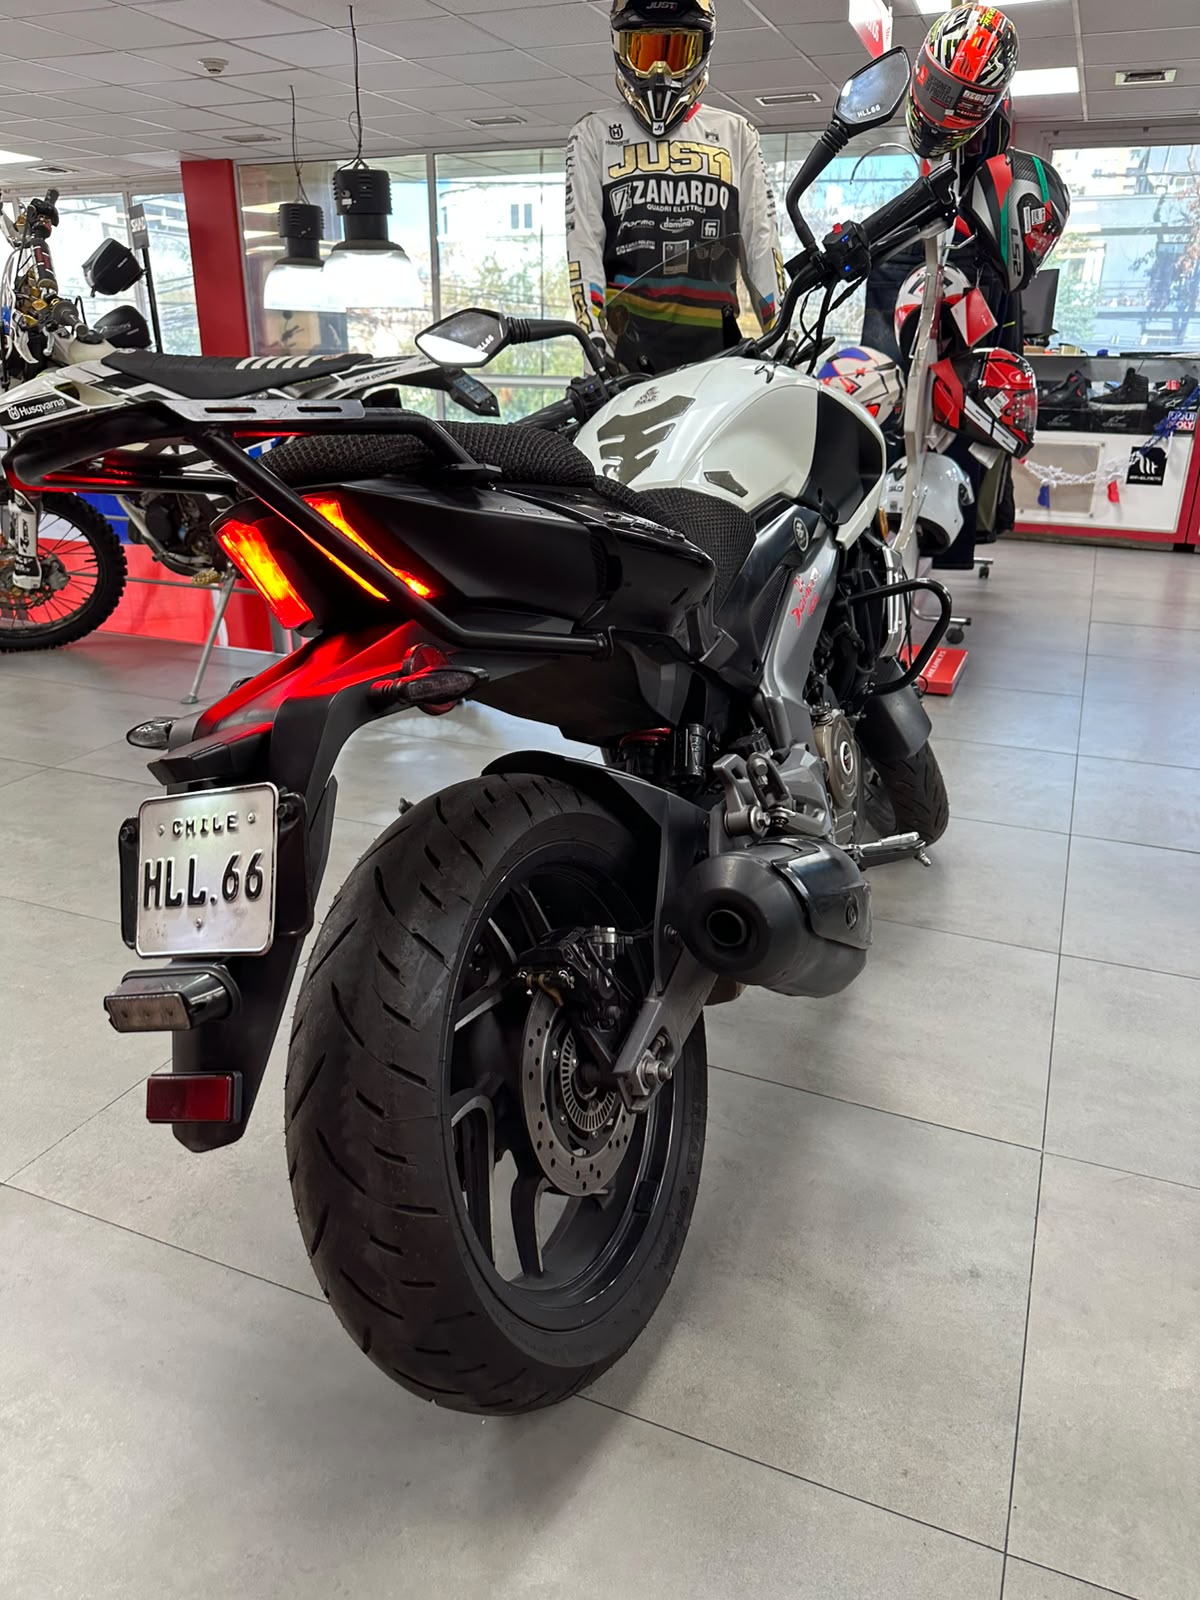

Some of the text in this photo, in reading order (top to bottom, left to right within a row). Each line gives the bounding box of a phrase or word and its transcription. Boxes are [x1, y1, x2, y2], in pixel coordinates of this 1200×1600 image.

[857, 104, 881, 118] HLL66
[632, 179, 729, 210] ZANARDO
[647, 204, 706, 214] QUADRI ELETTRICI
[19, 398, 66, 416] Husqvarna
[171, 814, 239, 838] CHILE
